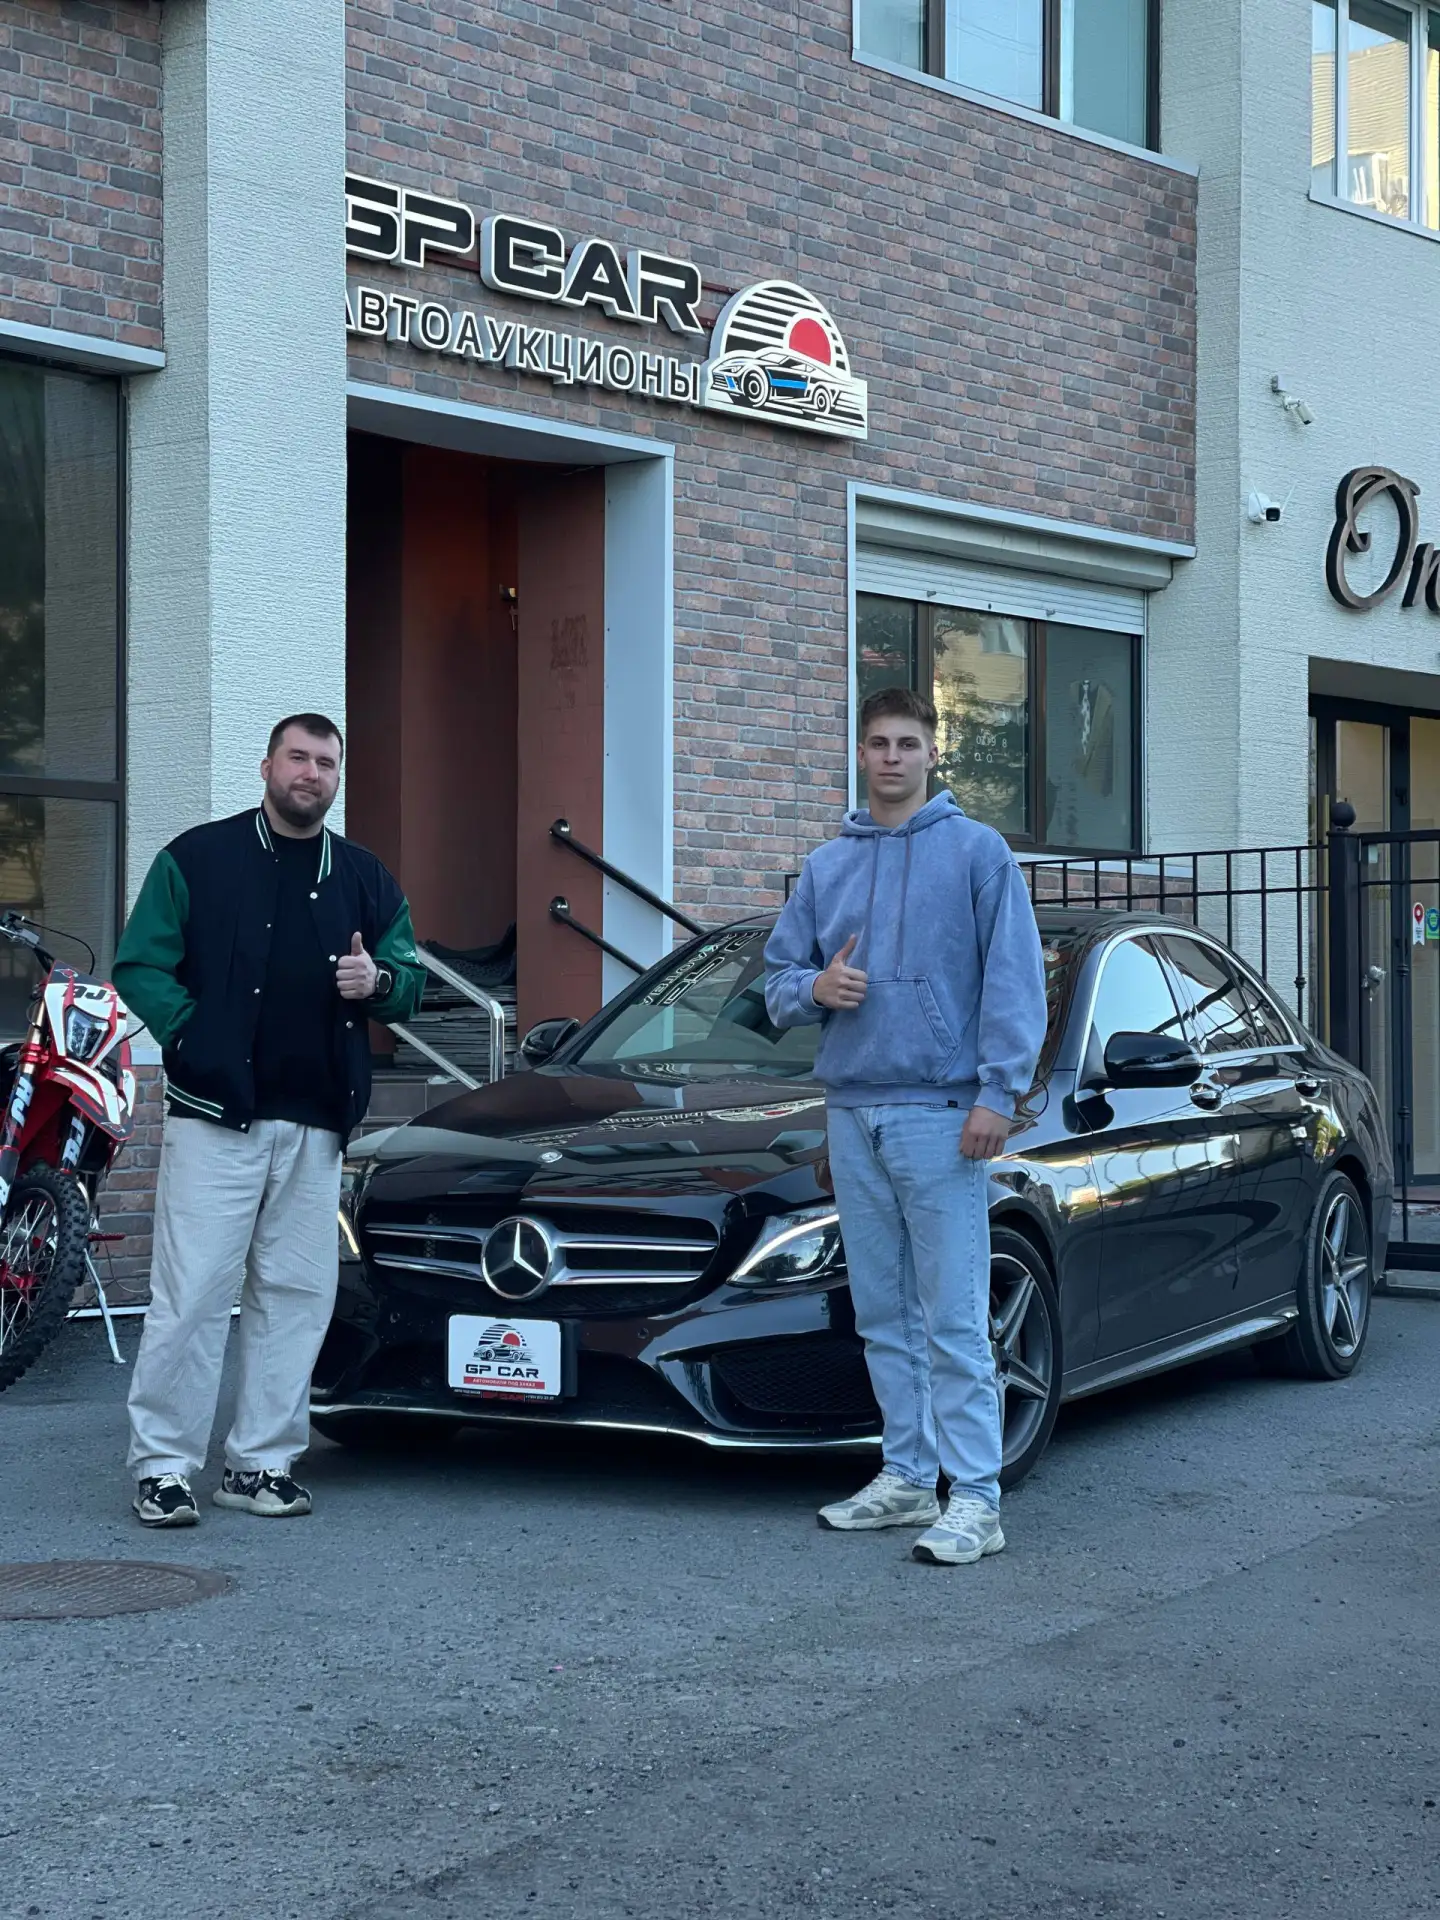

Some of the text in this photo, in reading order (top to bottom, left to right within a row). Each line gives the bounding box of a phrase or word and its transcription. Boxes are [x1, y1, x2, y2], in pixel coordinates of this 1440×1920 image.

[481, 213, 705, 335] CAR
[345, 286, 701, 405] ВТОАУКЦИОНЫ
[465, 1364, 539, 1378] GP CAR
